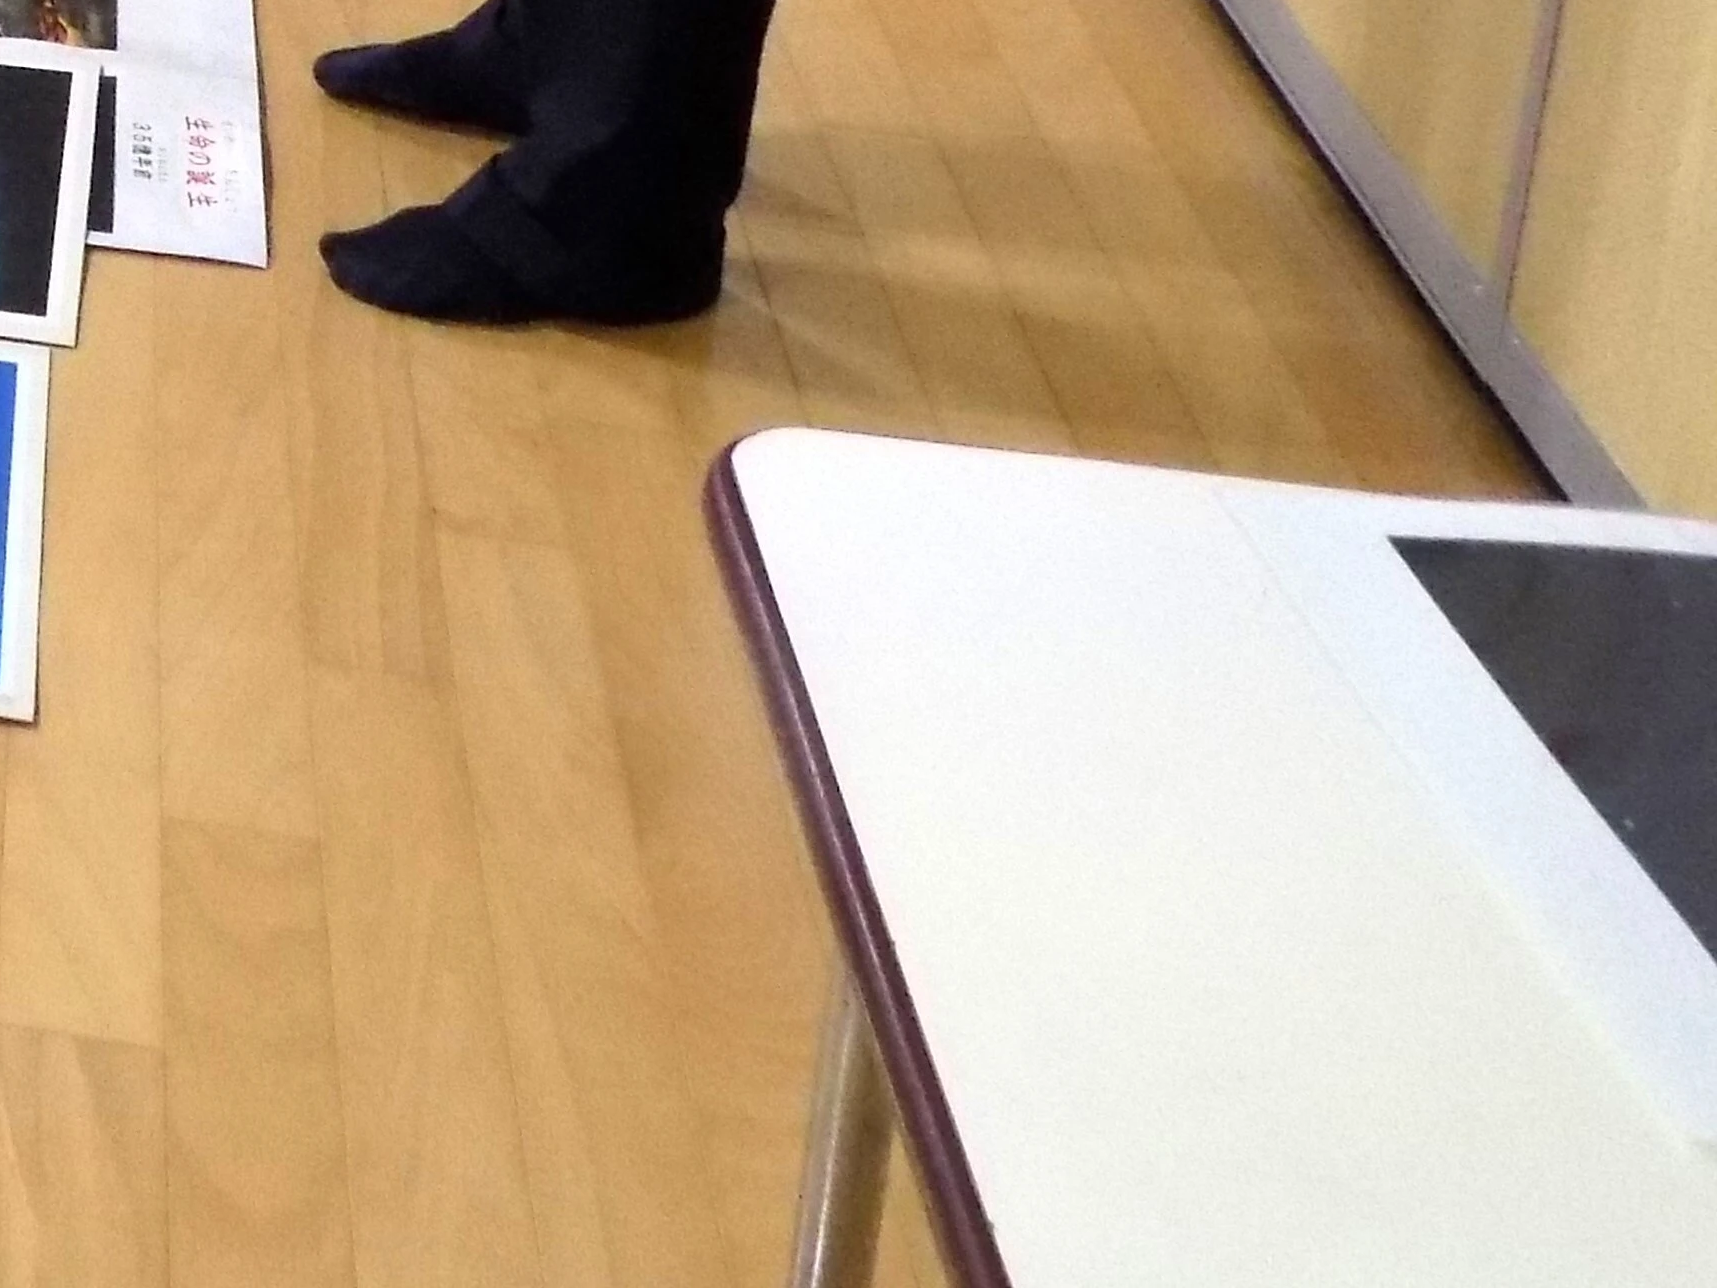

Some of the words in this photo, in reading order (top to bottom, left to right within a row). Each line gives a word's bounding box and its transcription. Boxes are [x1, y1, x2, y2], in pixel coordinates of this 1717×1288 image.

[184, 115, 218, 209] 生命の誕生
